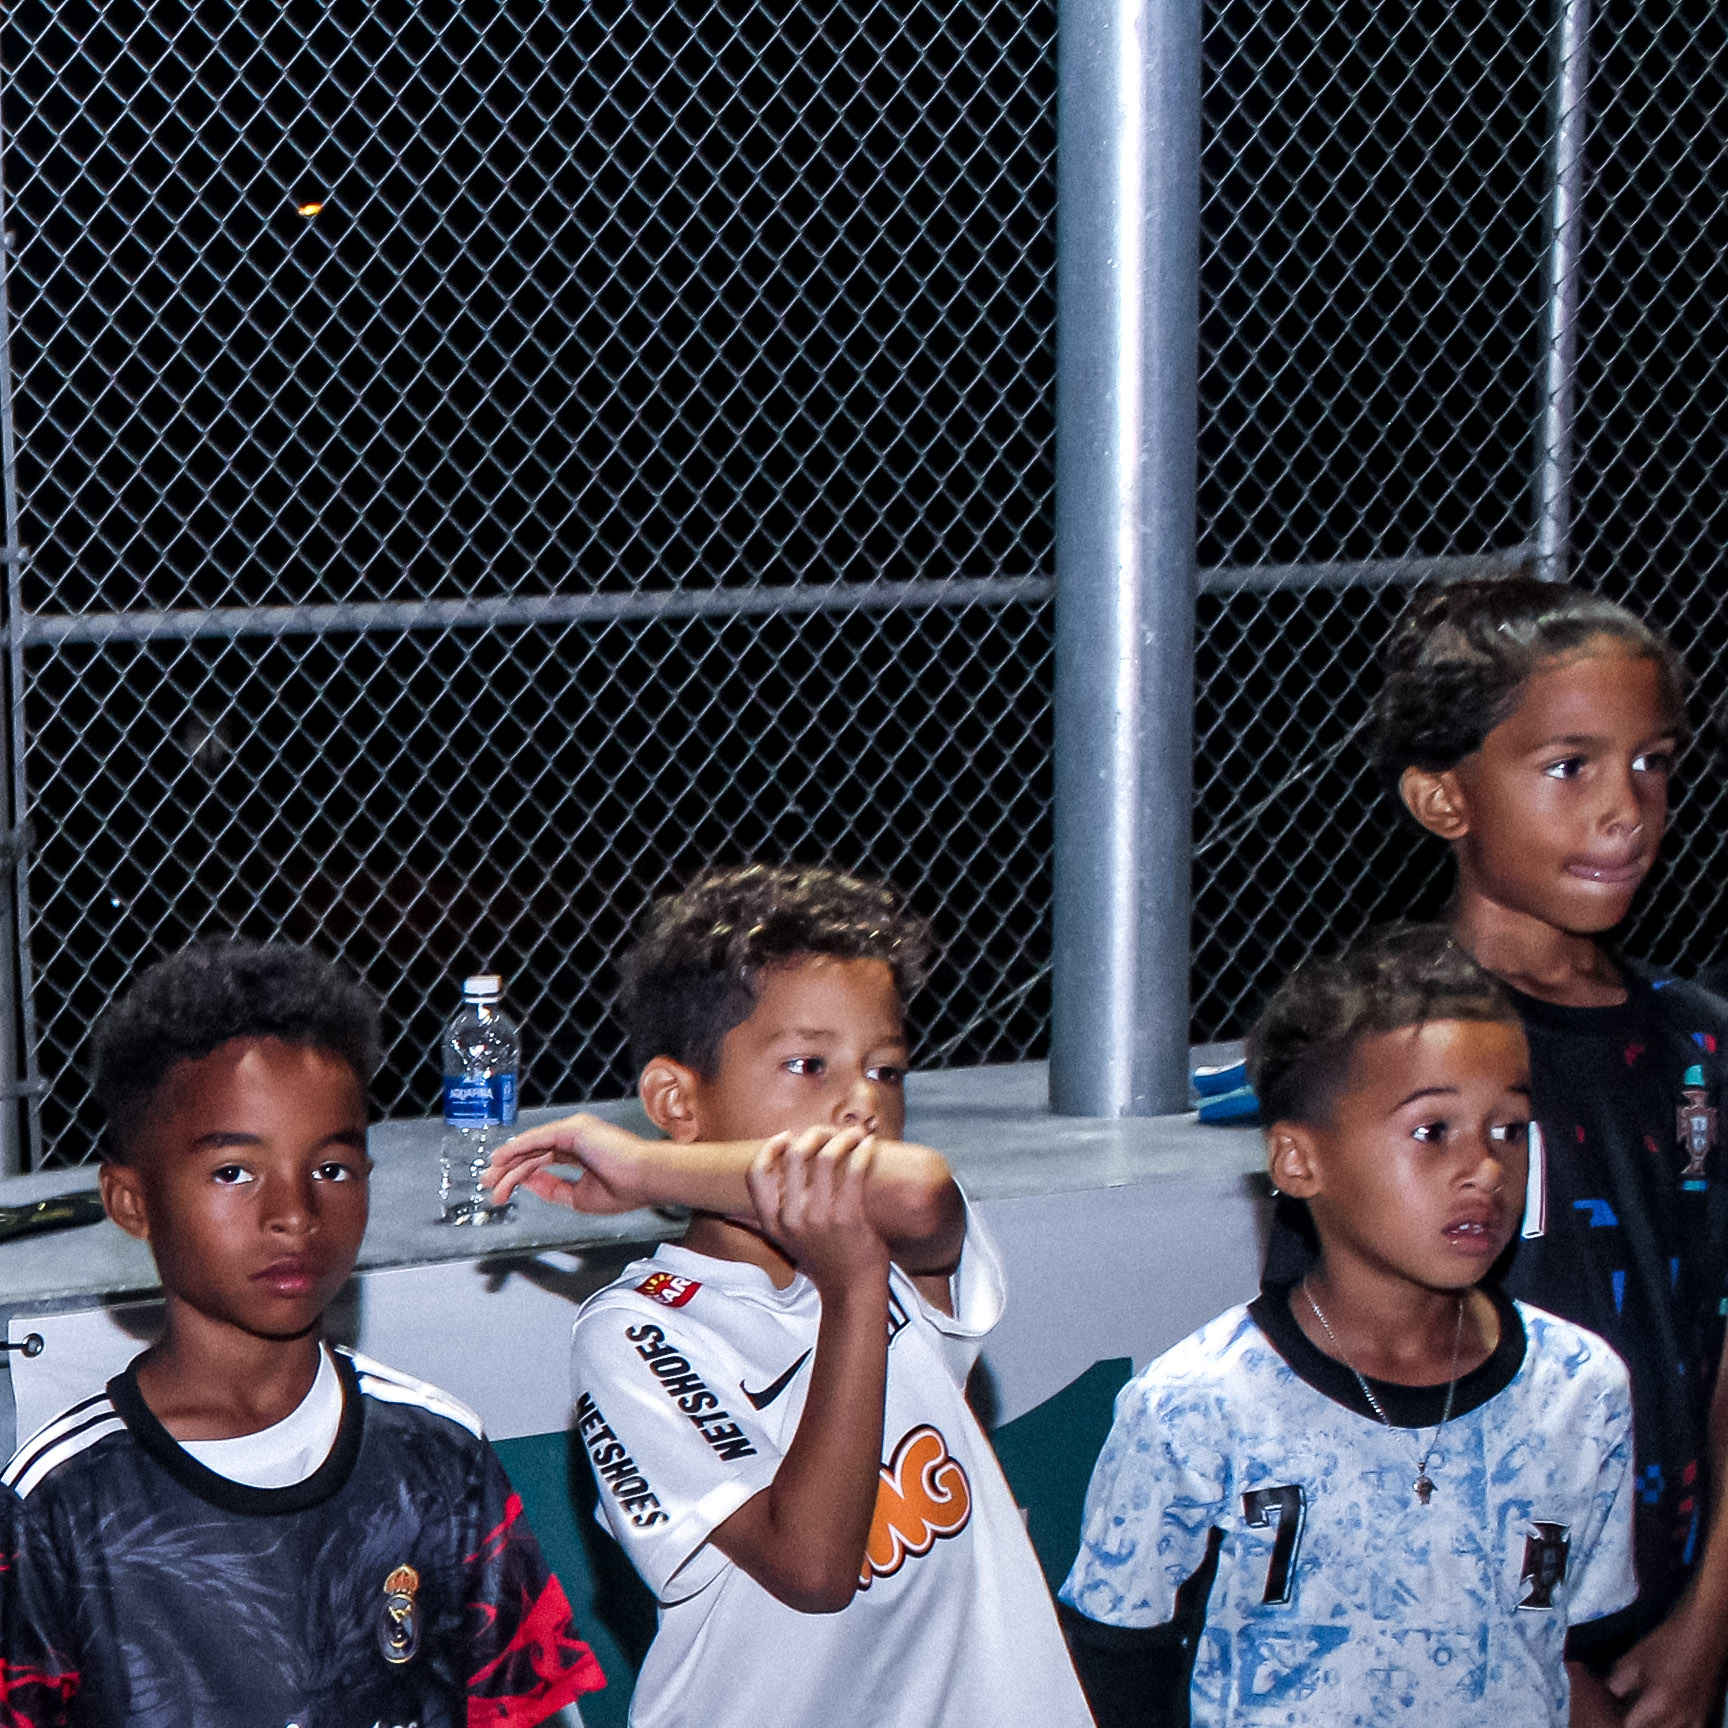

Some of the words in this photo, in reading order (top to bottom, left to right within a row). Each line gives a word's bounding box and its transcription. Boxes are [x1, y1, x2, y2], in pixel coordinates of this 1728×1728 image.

[576, 1390, 670, 1528] NETSHOES
[625, 1324, 758, 1463] NETSHOES
[1239, 1483, 1309, 1606] 7
